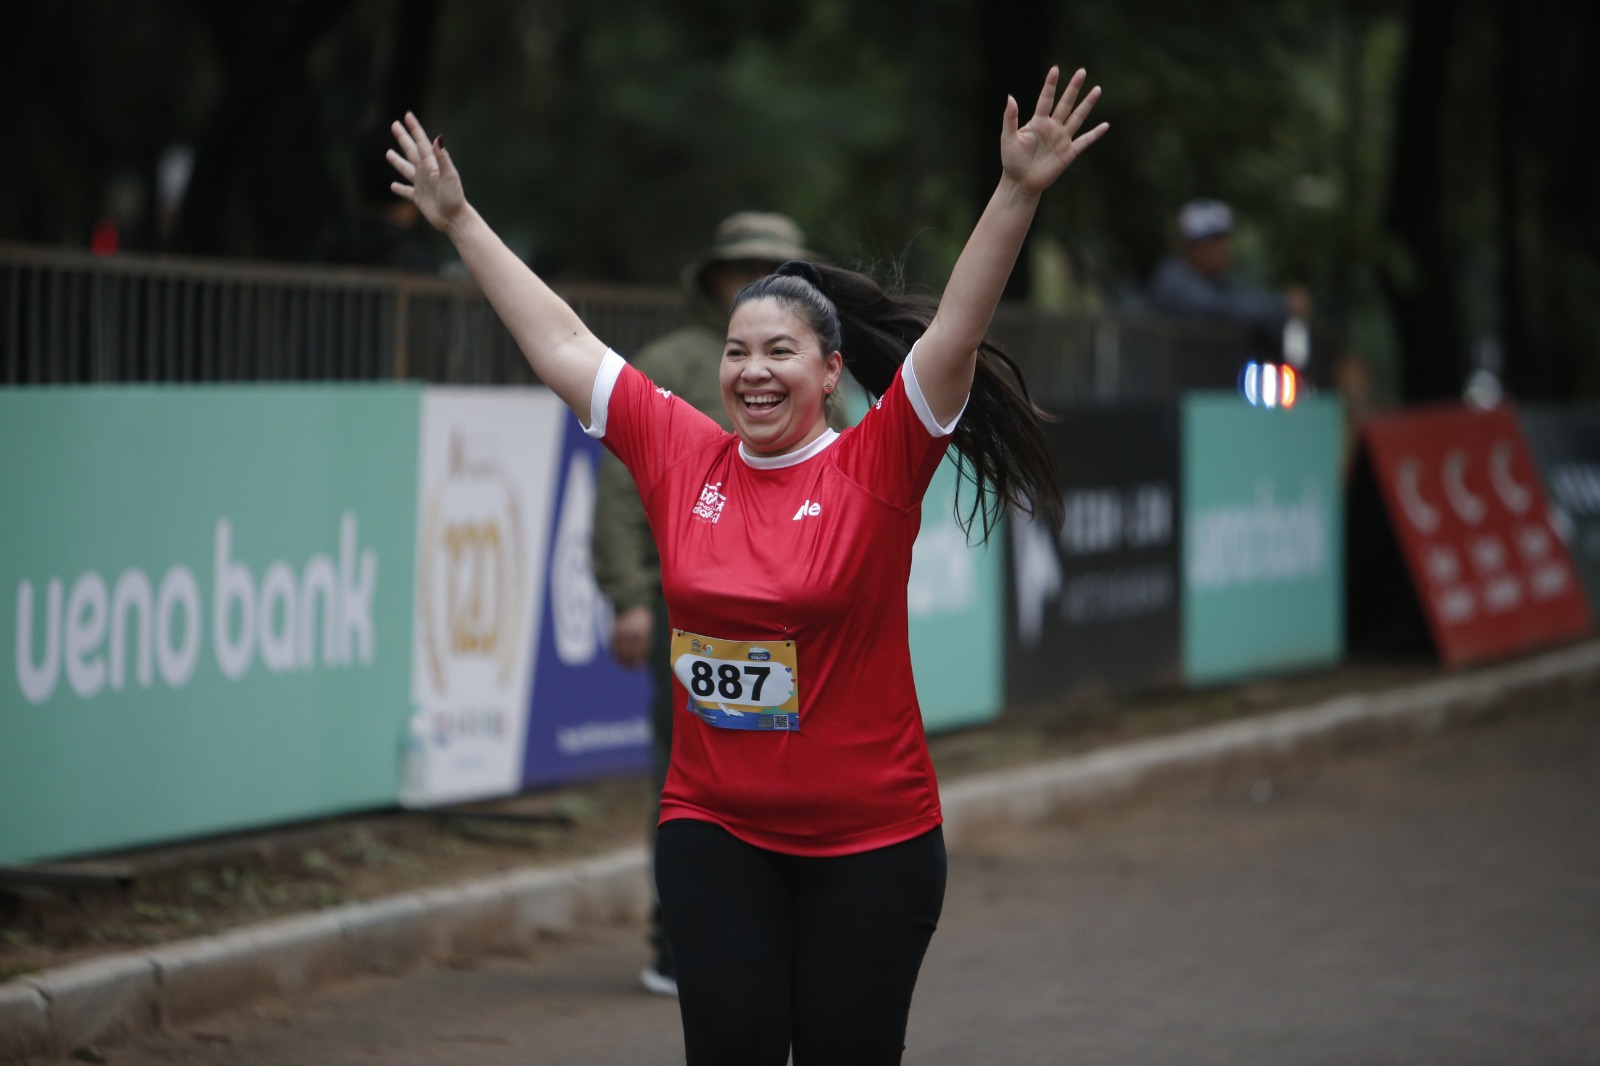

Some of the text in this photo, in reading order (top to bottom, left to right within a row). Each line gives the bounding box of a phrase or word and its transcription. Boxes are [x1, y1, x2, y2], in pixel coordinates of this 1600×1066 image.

[15, 509, 378, 703] ueno bank
[691, 660, 771, 702] 887
